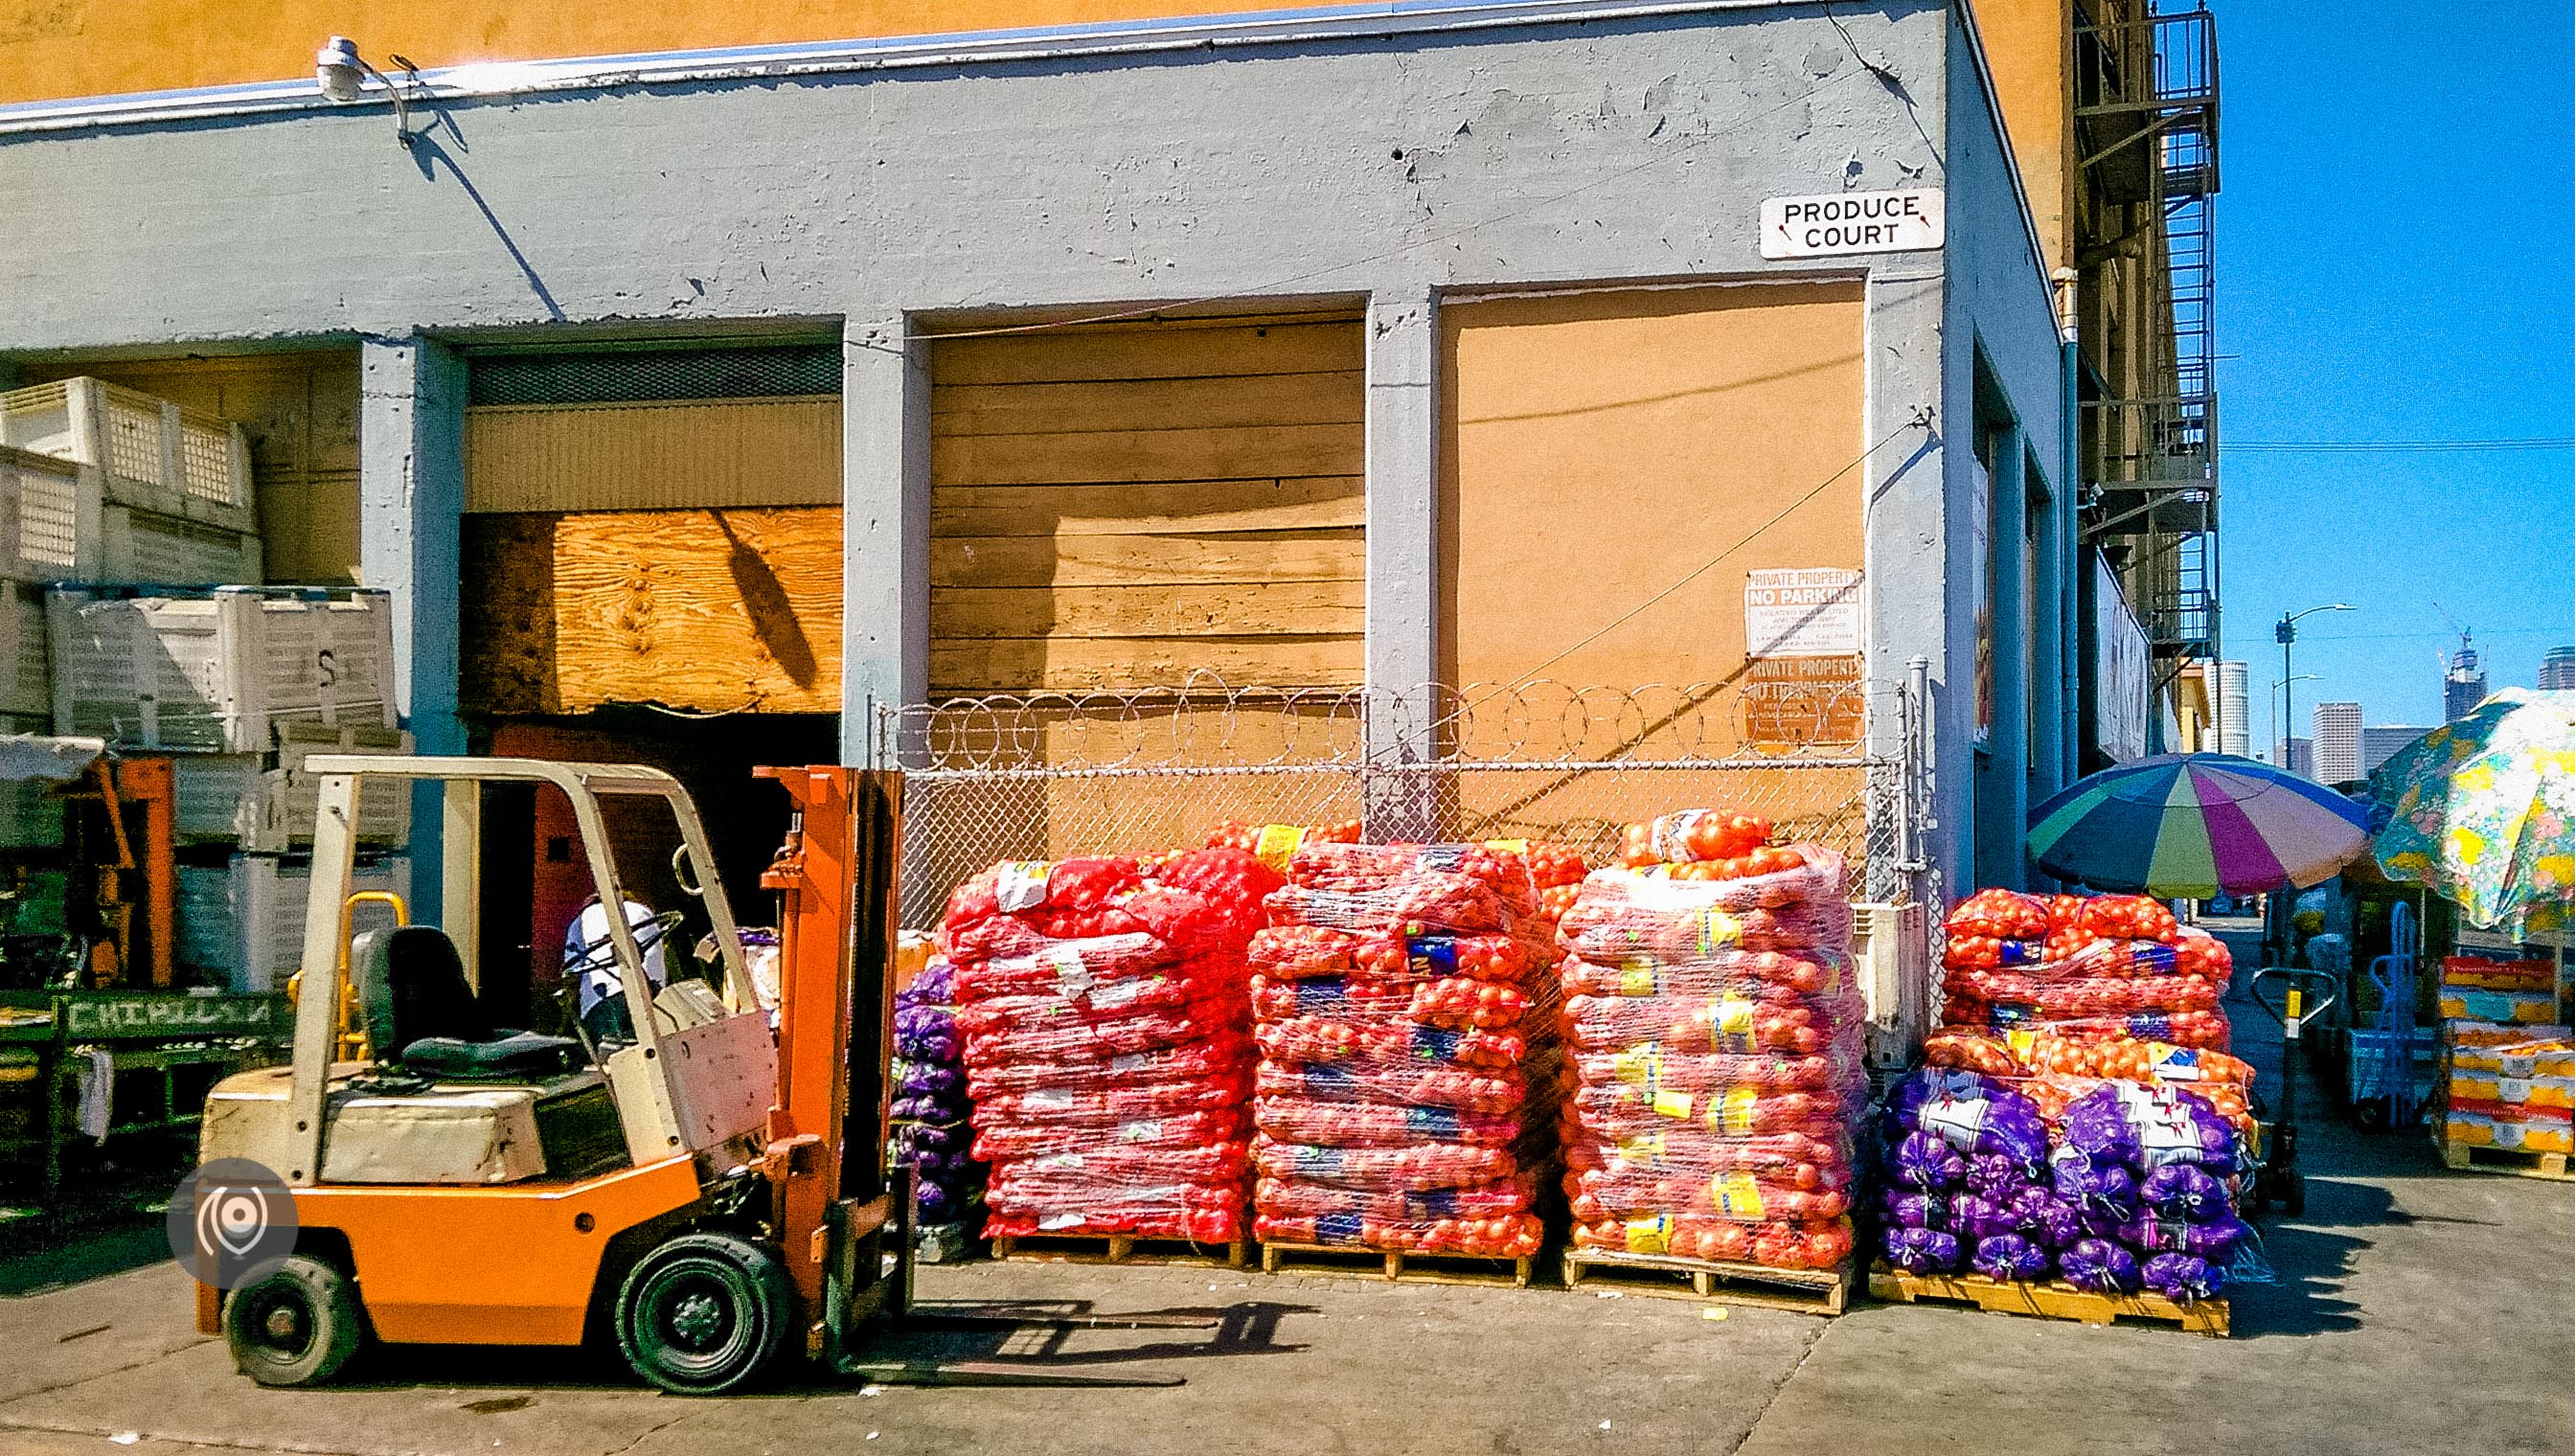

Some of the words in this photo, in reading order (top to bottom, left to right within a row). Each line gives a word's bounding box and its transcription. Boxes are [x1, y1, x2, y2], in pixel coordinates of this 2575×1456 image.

[1785, 195, 1920, 224] PRODUCE
[1805, 223, 1900, 248] COURT
[1748, 572, 1794, 586] PRIVATE
[1797, 571, 1858, 585] PROPERTY
[1749, 589, 1775, 605] NO
[1780, 587, 1858, 604] PARKING
[1751, 660, 1794, 677] RIVATE
